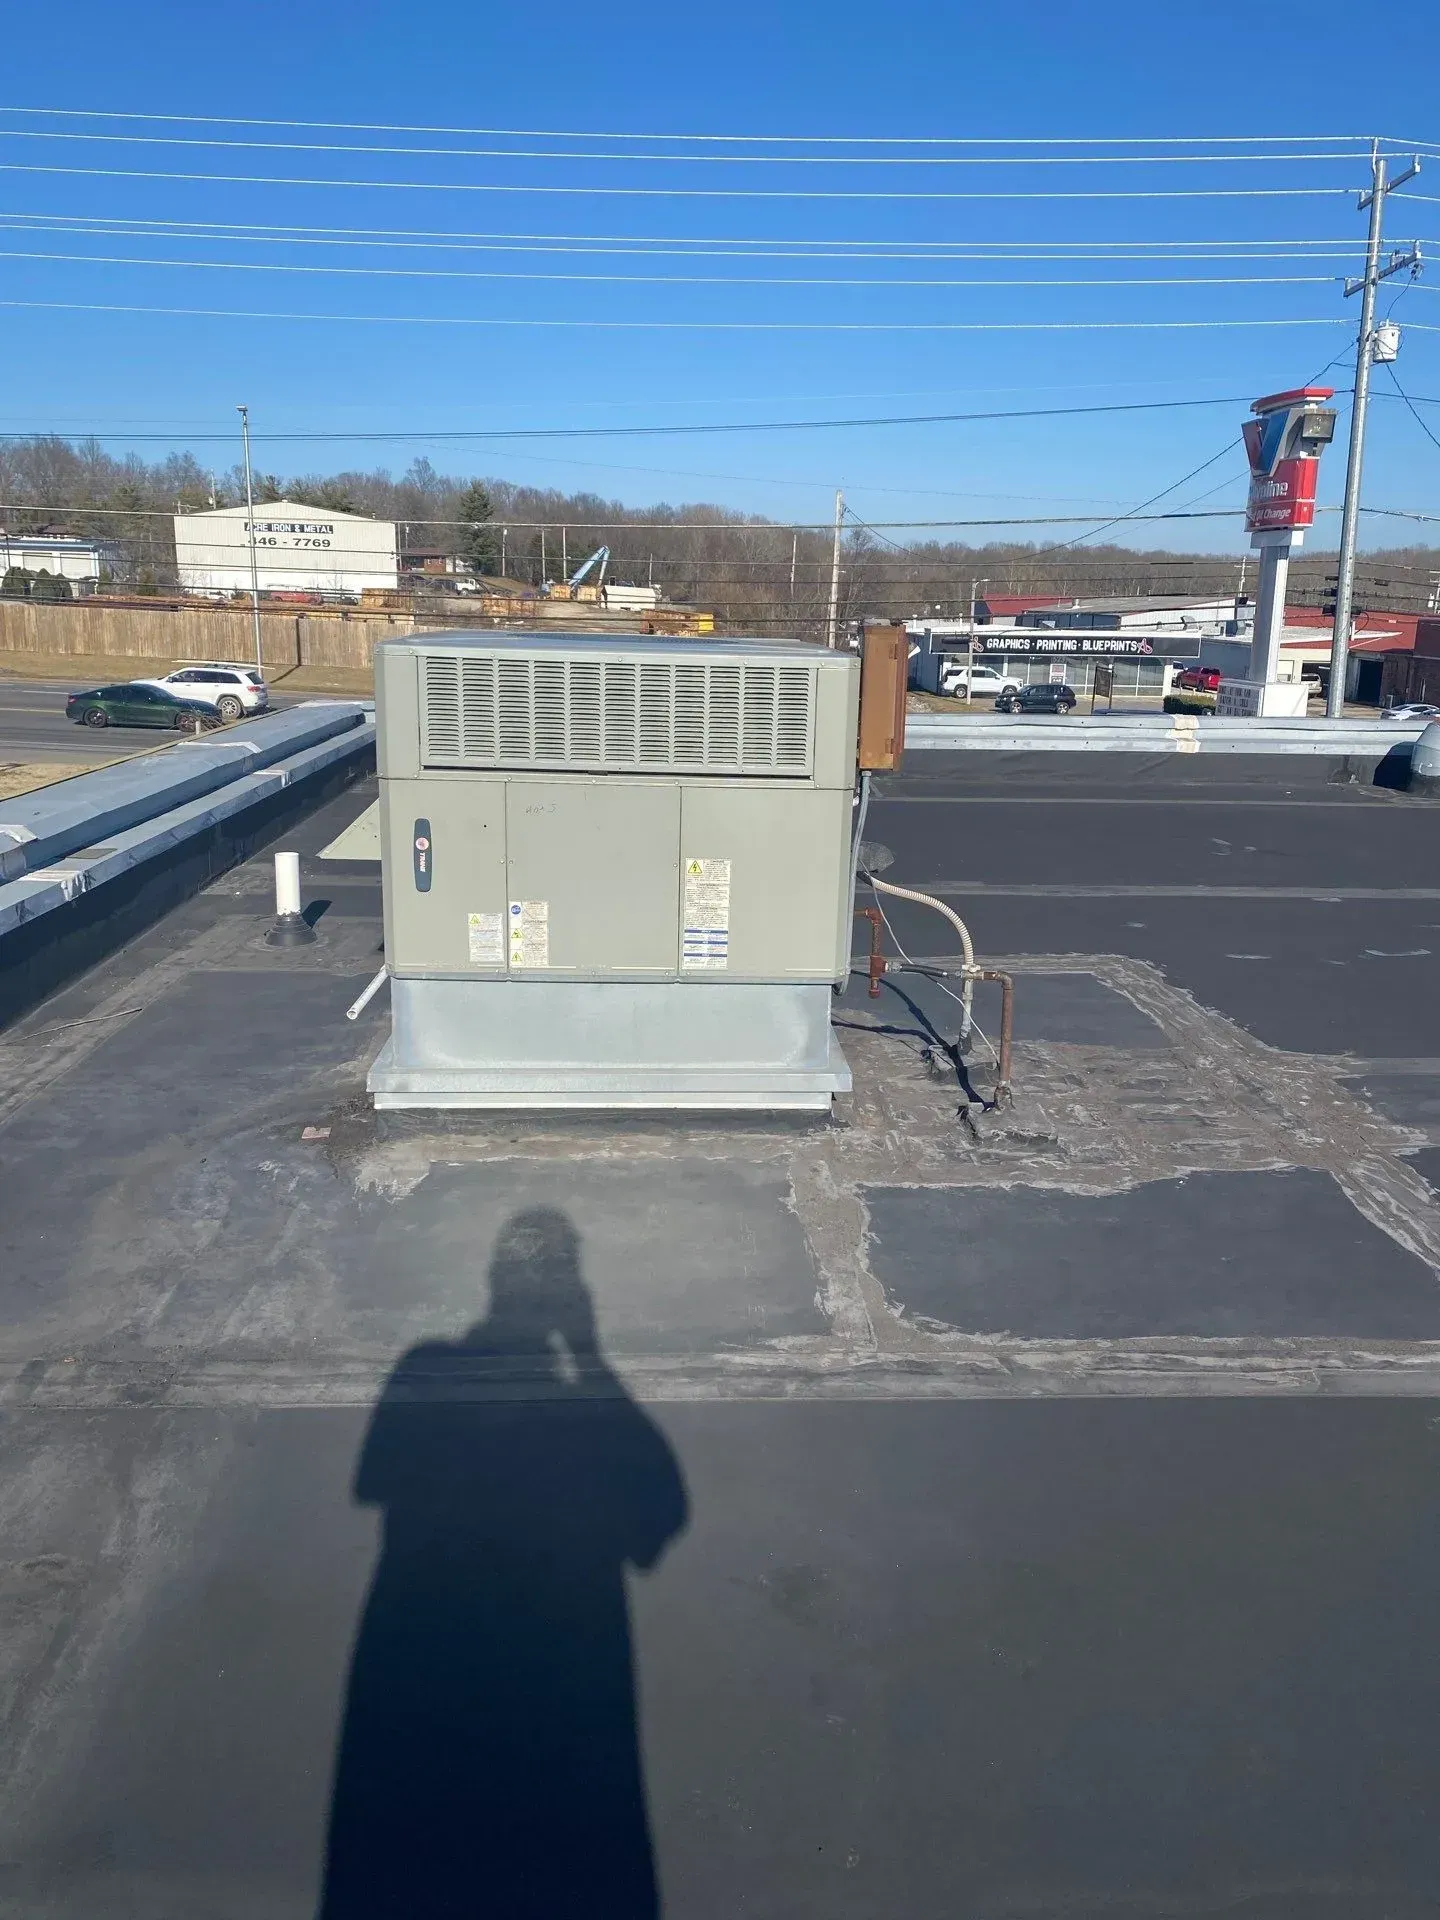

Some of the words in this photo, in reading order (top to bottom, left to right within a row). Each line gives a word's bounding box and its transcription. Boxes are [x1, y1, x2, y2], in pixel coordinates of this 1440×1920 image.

[1264, 508, 1291, 519] Change
[271, 523, 291, 532] IRON
[294, 524, 300, 532] &
[303, 525, 332, 533] METAL
[292, 538, 331, 547] 7769
[986, 638, 1031, 649] GRAPHICS
[1036, 639, 1077, 650] PRINTING
[1083, 640, 1137, 651] BLUEPRINTS
